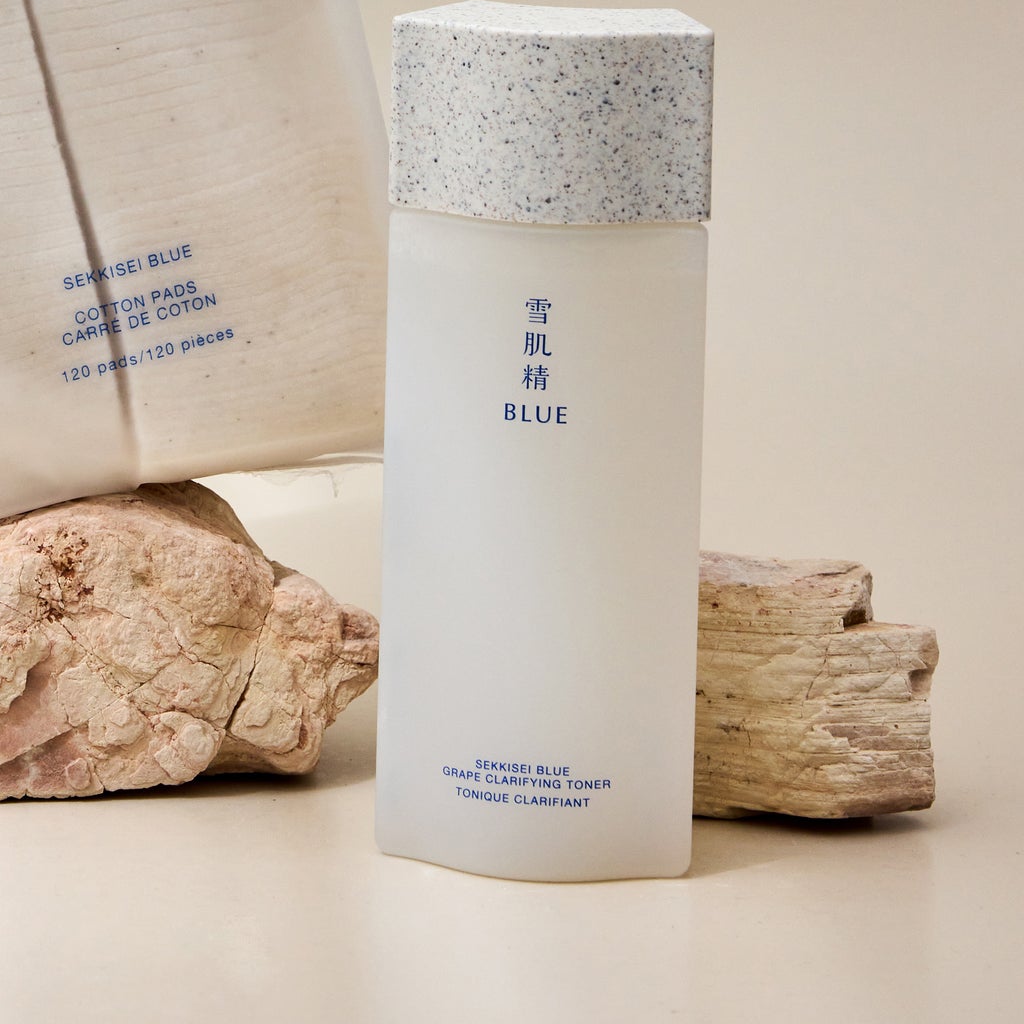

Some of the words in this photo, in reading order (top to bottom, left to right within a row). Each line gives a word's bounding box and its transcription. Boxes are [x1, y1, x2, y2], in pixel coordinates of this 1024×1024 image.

[63, 258, 142, 290] SEKKISEI
[148, 244, 193, 268] BLUE
[62, 317, 122, 346] CARRÉ
[128, 311, 151, 329] DE
[156, 293, 217, 321] COTON
[75, 295, 146, 324] COTTON
[151, 280, 197, 304] PADS
[62, 364, 91, 383] 120
[97, 342, 175, 376] pads/120
[181, 328, 234, 354] pièces
[521, 298, 552, 391] 雪肌精
[504, 402, 567, 425] BLUE
[442, 766, 481, 782] GRAPE
[485, 773, 561, 789] CLARIFYING
[566, 779, 611, 790] TONER
[475, 759, 531, 774] SEKKISEI
[536, 765, 570, 777] BLUE
[455, 786, 509, 803] TONIQUE
[514, 794, 590, 808] CLARIFIANT
